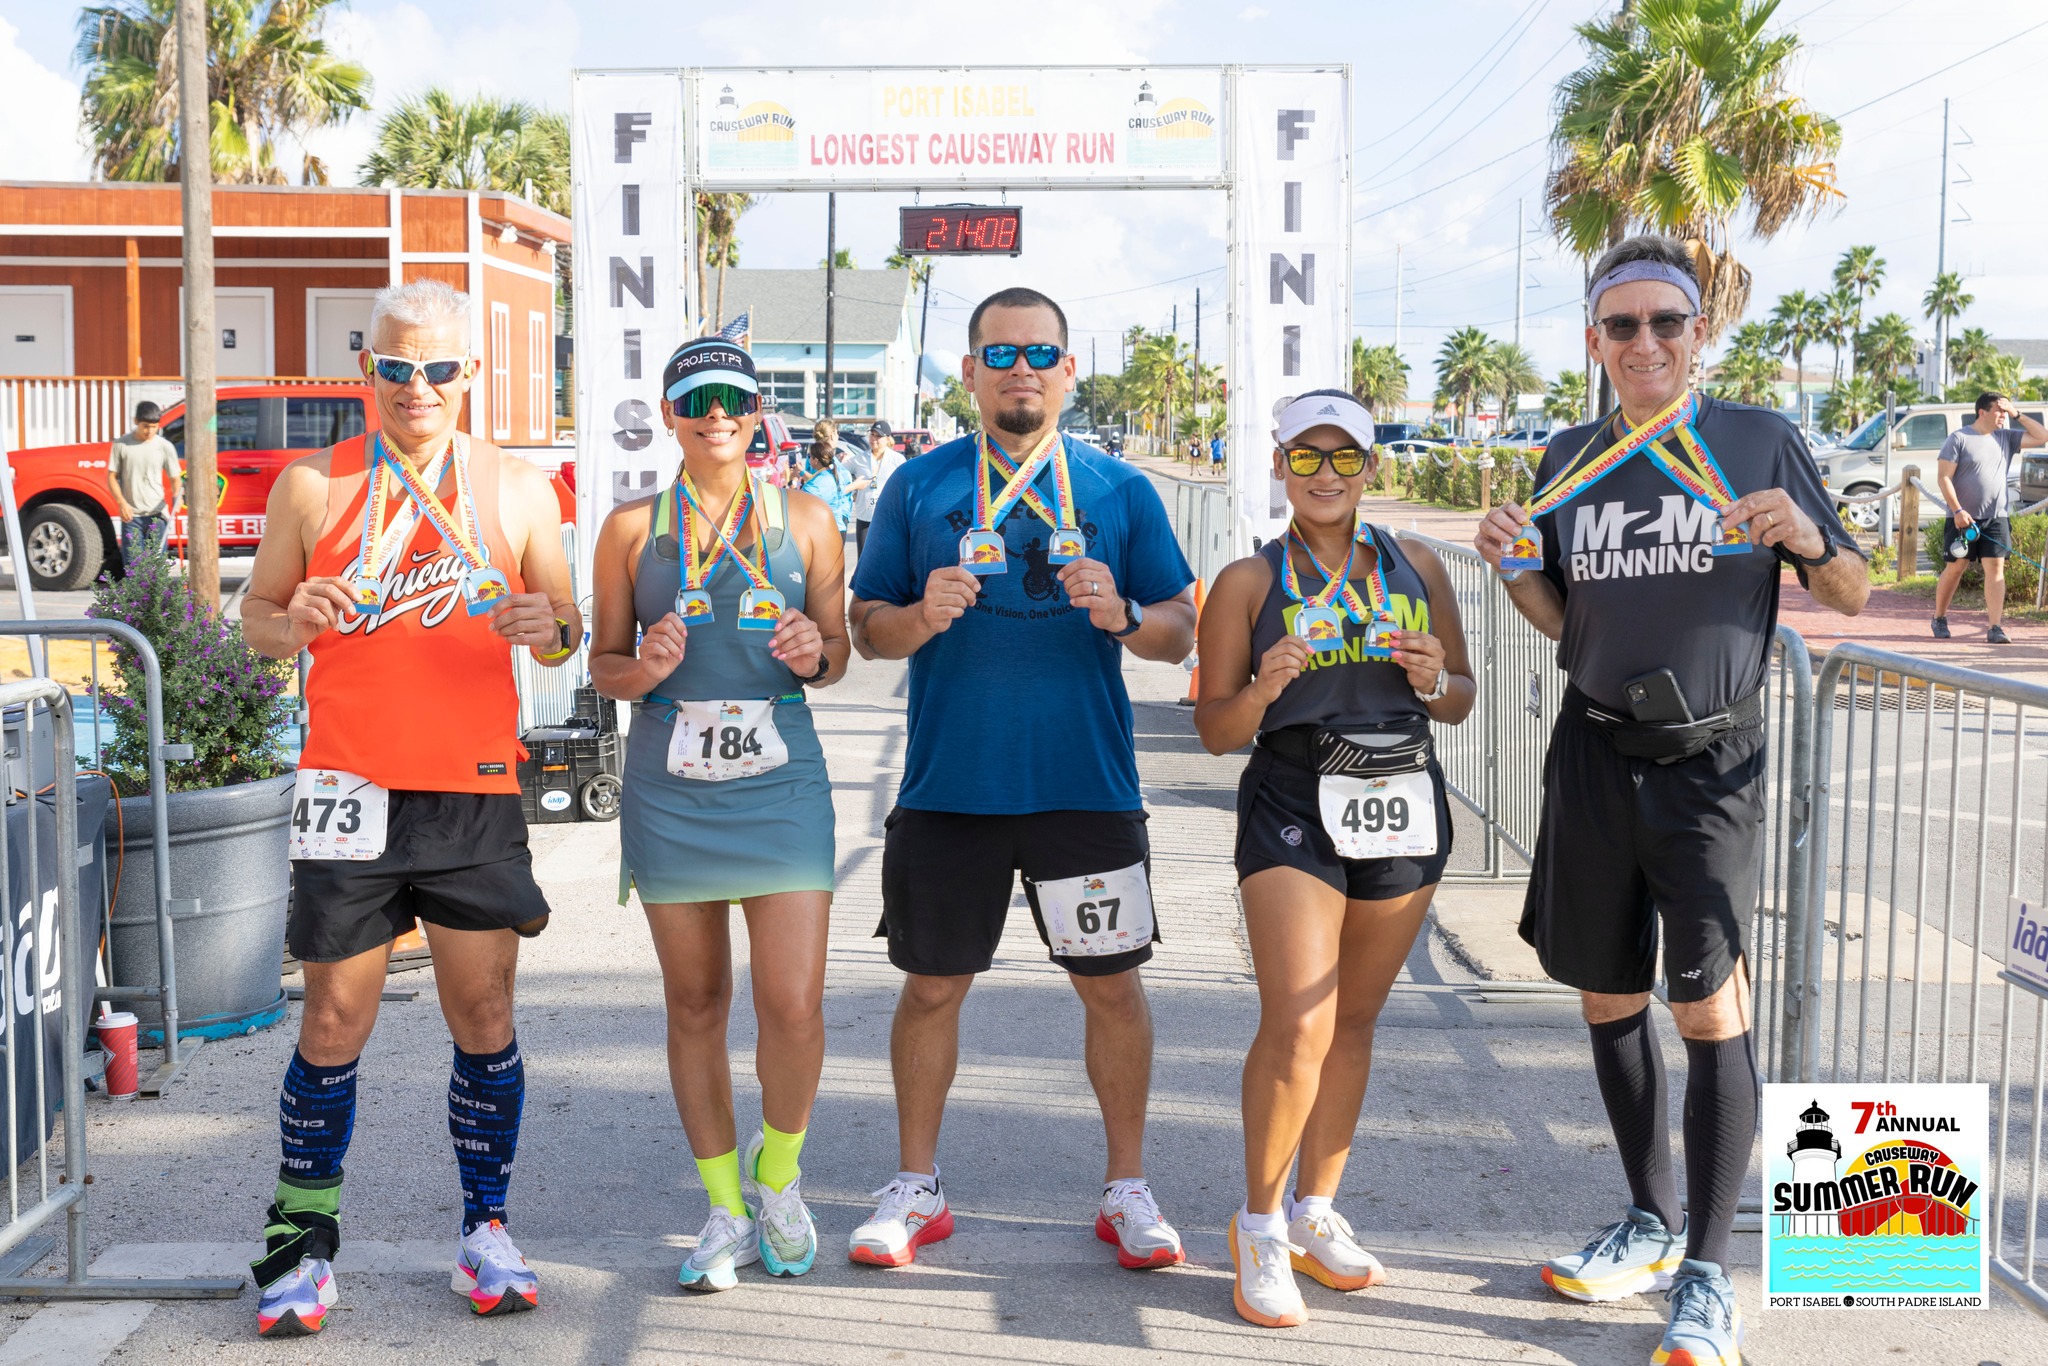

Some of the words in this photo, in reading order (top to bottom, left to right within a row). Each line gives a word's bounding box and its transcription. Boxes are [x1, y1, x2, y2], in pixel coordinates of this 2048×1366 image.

[883, 86, 944, 117] PORT
[953, 85, 1035, 117] ISABEL
[710, 112, 769, 132] CAUSEWAY
[772, 112, 796, 130] RUN
[1128, 110, 1188, 129] CAUSEWAY
[1190, 110, 1215, 126] RUN
[811, 134, 919, 165] LONGEST
[928, 132, 1057, 165] CAUSEWAY
[1067, 132, 1114, 163] RUN
[1582, 449, 1628, 483] SUMMER
[1627, 407, 1682, 451] CAUSEWAY
[1691, 443, 1708, 463] RUN
[372, 455, 383, 492] SUMMER
[1007, 463, 1036, 500] MEDALIST
[1669, 465, 1706, 497] FINISHER
[366, 493, 379, 542] CAUSEWAY
[400, 467, 431, 507] SUMMER
[427, 503, 465, 553] CAUSEWAY
[462, 549, 480, 571] RUN
[726, 495, 750, 536] CAUSEWAY
[976, 488, 985, 524] CAUSEWAY
[465, 503, 478, 547] MEDALIST
[681, 517, 692, 551] CAUSEWAY
[362, 545, 372, 564] RUN
[684, 553, 692, 566] RUN
[1571, 544, 1714, 582] RUNNING
[995, 605, 1028, 619] Vision,
[1029, 608, 1049, 620] One
[1050, 603, 1075, 617] Voice
[1341, 590, 1358, 612] RUN
[699, 726, 763, 760] 184
[292, 798, 362, 834] 473
[1341, 797, 1409, 833] 499
[1076, 897, 1121, 934] 67
